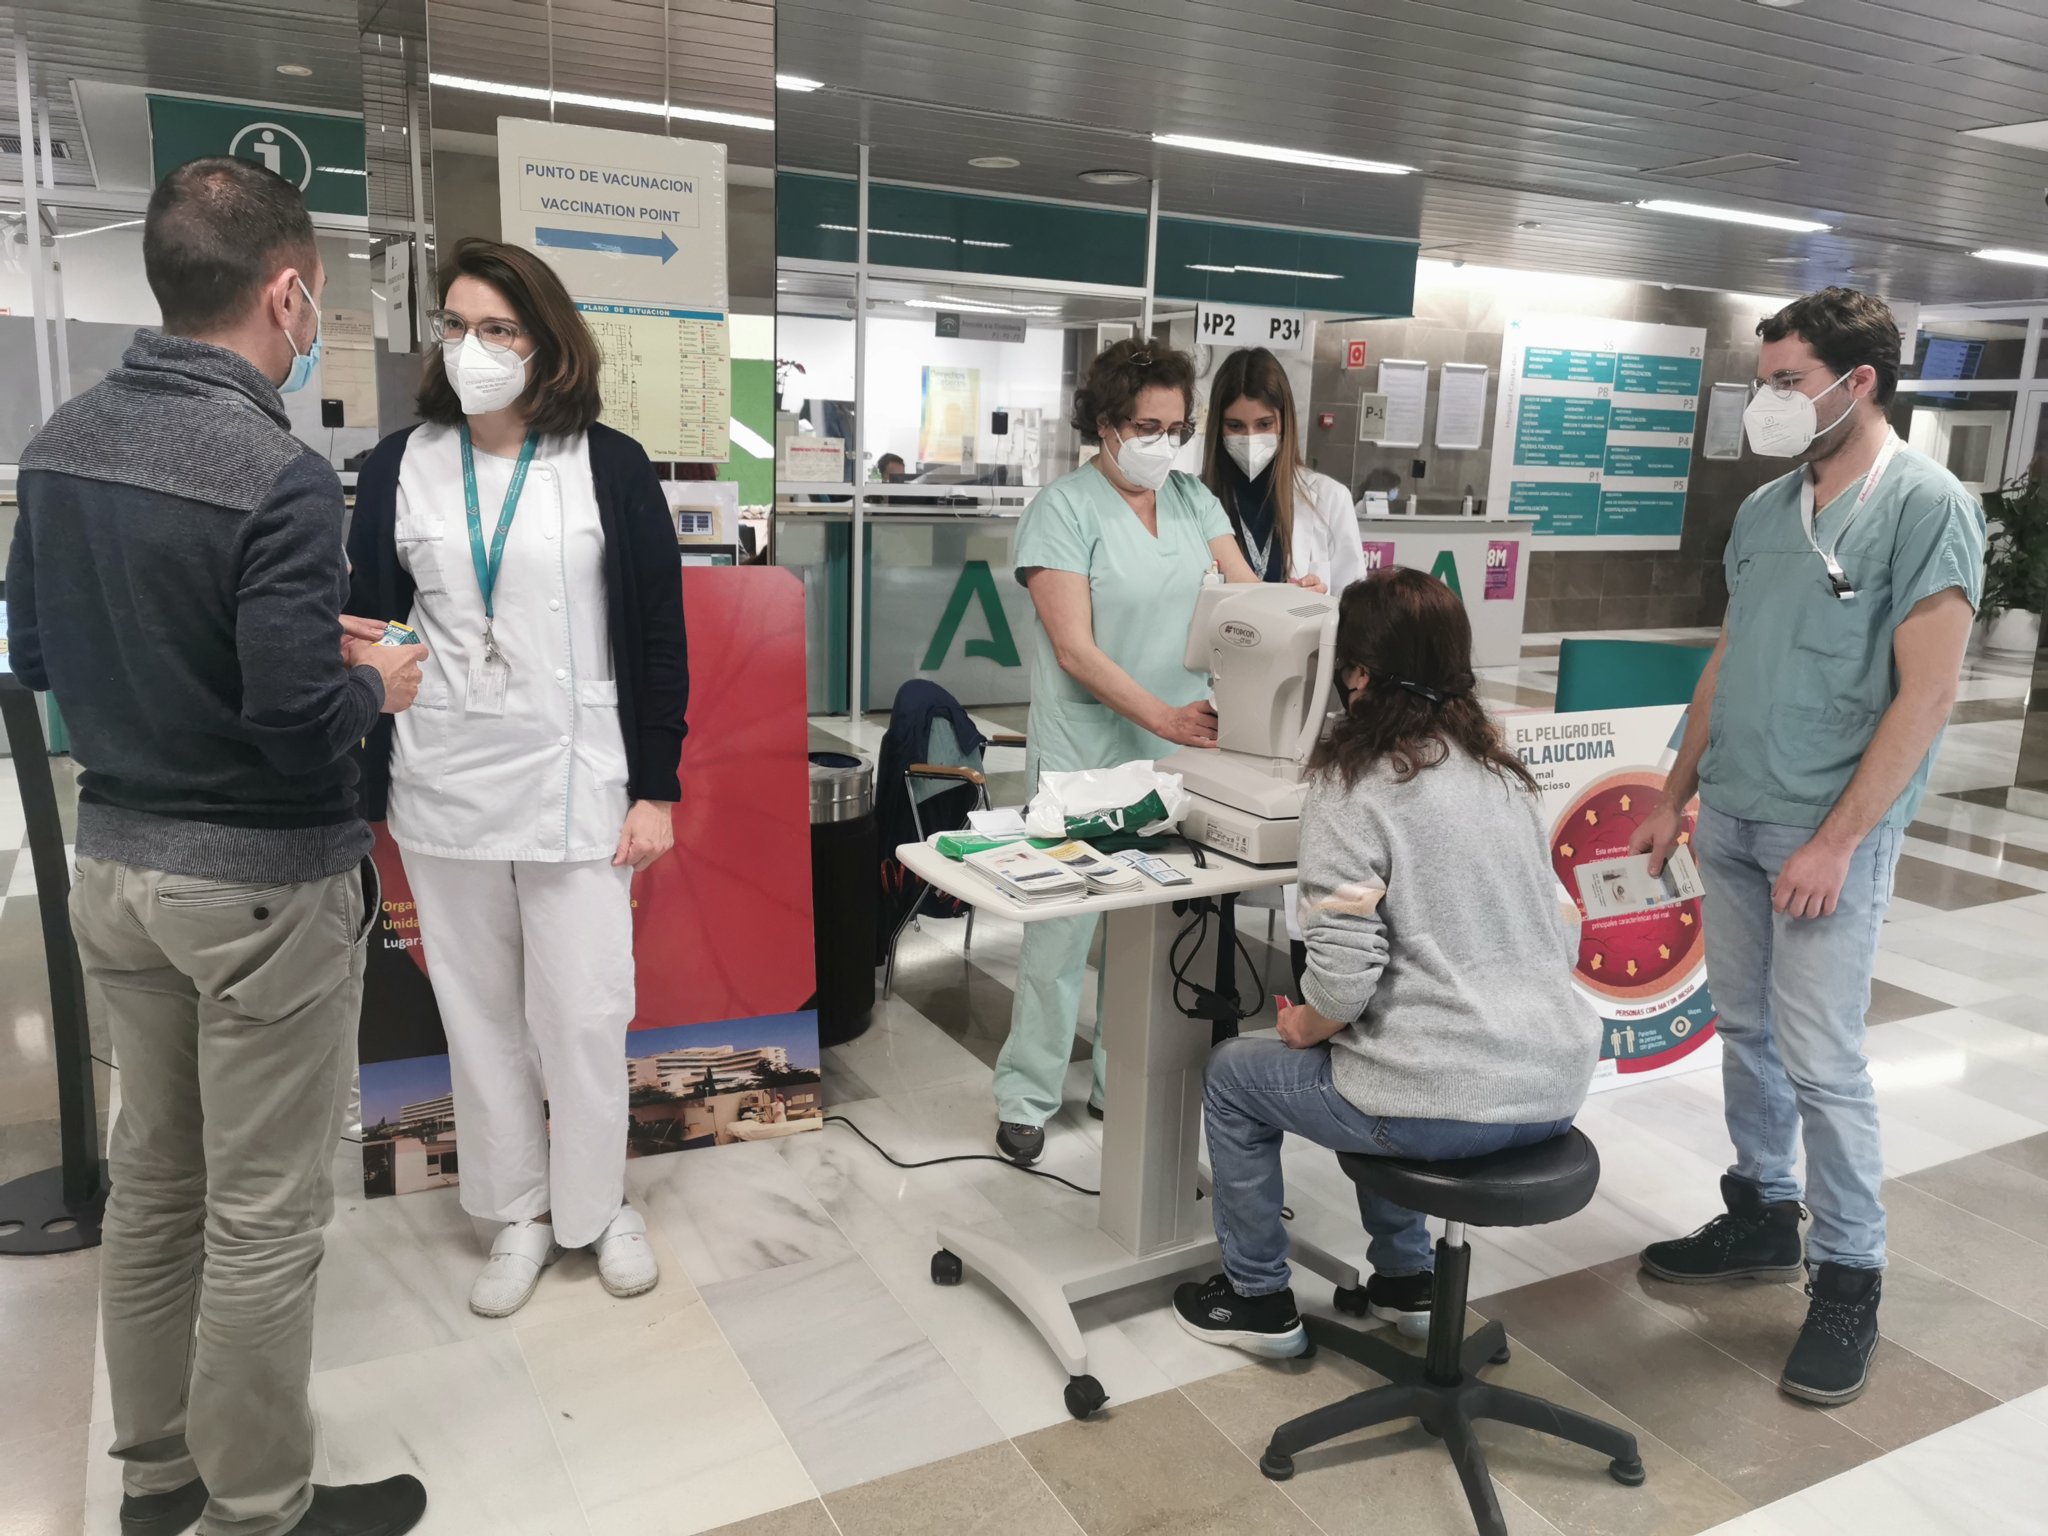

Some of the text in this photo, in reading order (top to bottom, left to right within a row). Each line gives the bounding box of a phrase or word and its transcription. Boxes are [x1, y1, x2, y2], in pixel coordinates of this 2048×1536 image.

[525, 164, 693, 194] PUNTO DE VACUNACION
[540, 197, 681, 222] VACCINATION POINT
[583, 304, 610, 313] PLANO
[628, 307, 670, 317] SITUACION
[1211, 313, 1236, 336] P2
[1269, 317, 1293, 341] P3
[1689, 346, 1700, 357] P2
[1683, 399, 1694, 410] P3
[1365, 406, 1383, 420] P-1
[1678, 436, 1689, 446] P4
[1588, 471, 1600, 481] P1
[1673, 480, 1684, 491] P5
[1486, 548, 1507, 568] 8M
[1232, 627, 1255, 639] TOPCON
[1516, 722, 1616, 743] EL PELIGRO DEL
[1517, 740, 1616, 766] GLAUCOMA
[1535, 769, 1554, 780] mal
[383, 936, 424, 950] Lugar:
[1615, 1009, 1645, 1017] PERSONAS
[1645, 1006, 1657, 1015] CON
[1657, 997, 1677, 1012] MAYOR
